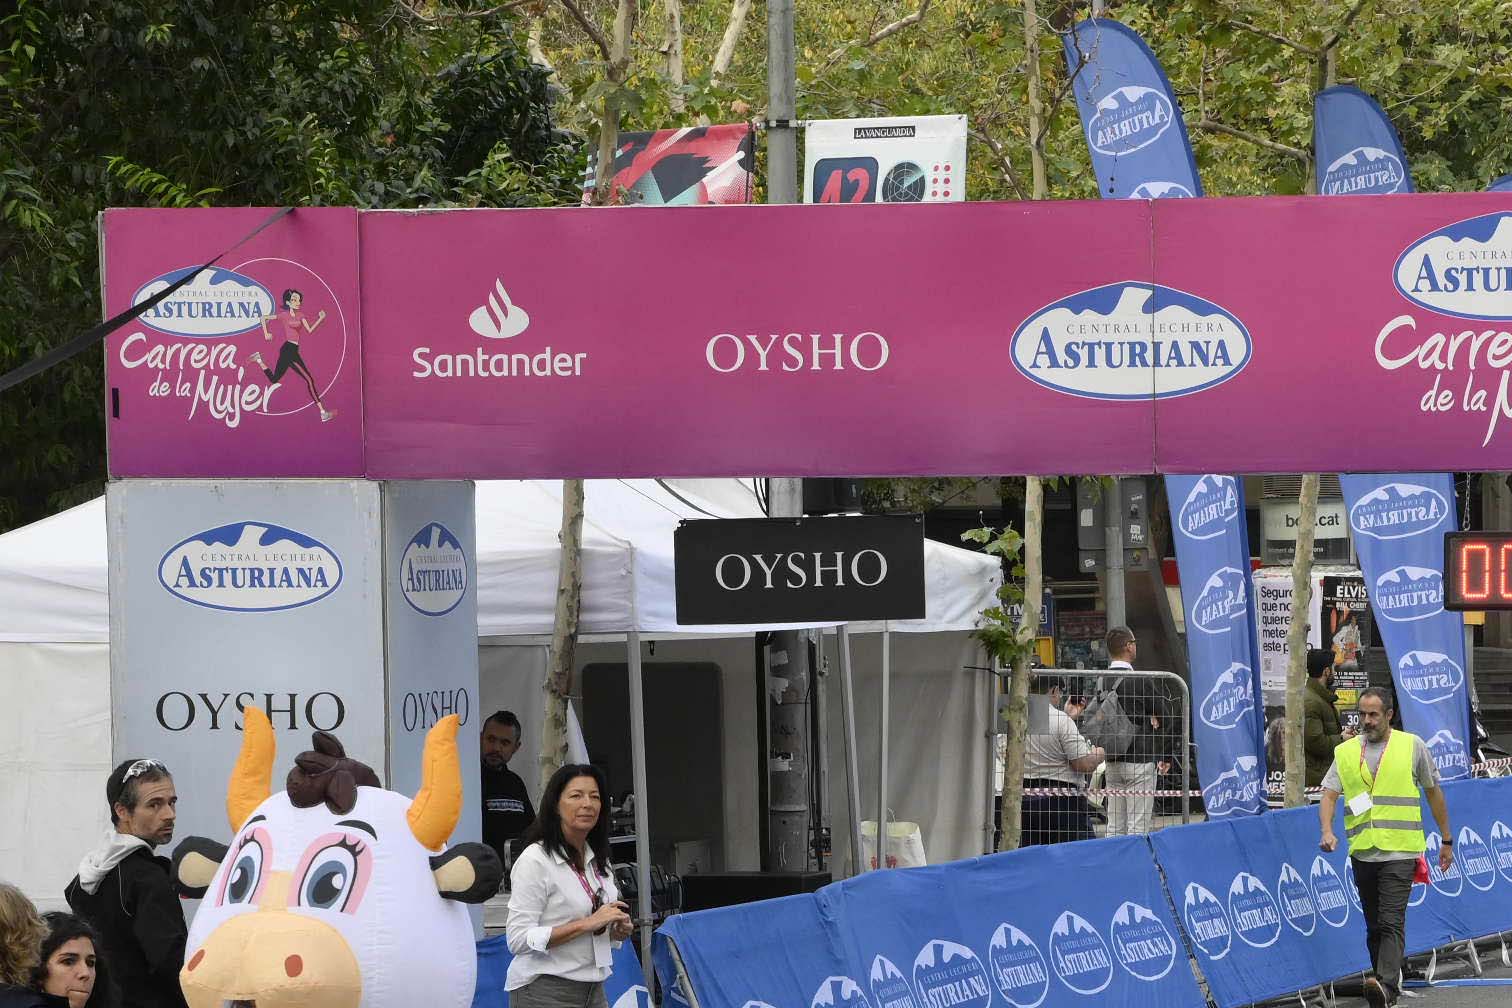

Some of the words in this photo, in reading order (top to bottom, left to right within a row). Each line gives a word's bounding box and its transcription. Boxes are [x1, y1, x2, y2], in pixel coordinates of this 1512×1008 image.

[144, 291, 263, 318] ASTURIANA
[172, 289, 211, 298] ENTRAL
[1066, 323, 1140, 334] CENTRAL
[1150, 322, 1224, 333] LECHERA
[120, 332, 237, 370] Carrera
[412, 346, 586, 378] Santander
[705, 332, 890, 372] OYSHO
[1029, 326, 1233, 370] ASTURIANA
[149, 370, 171, 397] de
[176, 370, 190, 397] la
[188, 366, 282, 428] Mujer
[1420, 374, 1454, 412] de
[1463, 373, 1488, 412] la
[173, 555, 329, 588] ASTURIANA
[201, 552, 258, 562] CENTRAL
[265, 552, 322, 562] LECHERA
[716, 550, 888, 590] OYSHO
[406, 558, 463, 592] ASTURIANA
[1262, 602, 1278, 612] que
[1336, 586, 1367, 598] ELVIS
[1262, 613, 1294, 626] quiere
[1263, 642, 1281, 652] este
[156, 692, 345, 732] OYSHO
